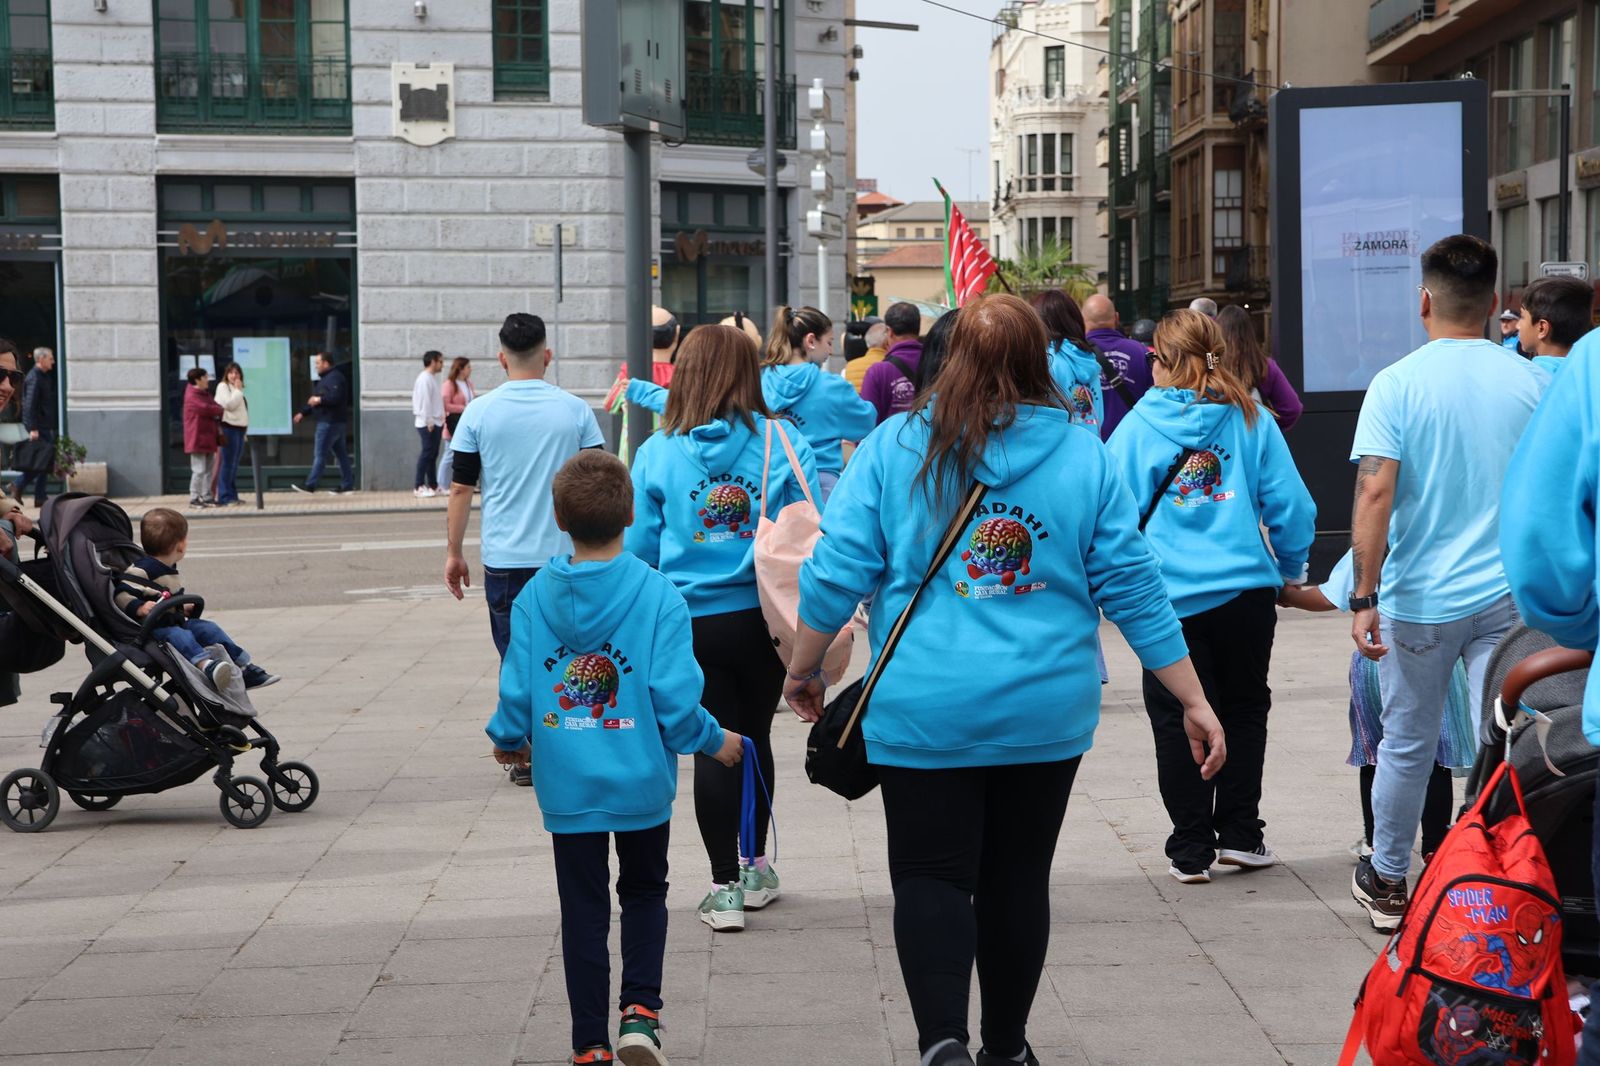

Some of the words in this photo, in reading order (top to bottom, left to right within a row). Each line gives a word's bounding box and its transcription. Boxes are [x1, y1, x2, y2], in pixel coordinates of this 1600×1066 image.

[1354, 239, 1408, 251] ZAMORA
[971, 502, 1049, 541] ADAHI
[543, 642, 633, 675] AZAHI
[1447, 888, 1493, 907] SPIDER
[1465, 905, 1508, 924] -MAN
[1481, 1007, 1517, 1026] MILES
